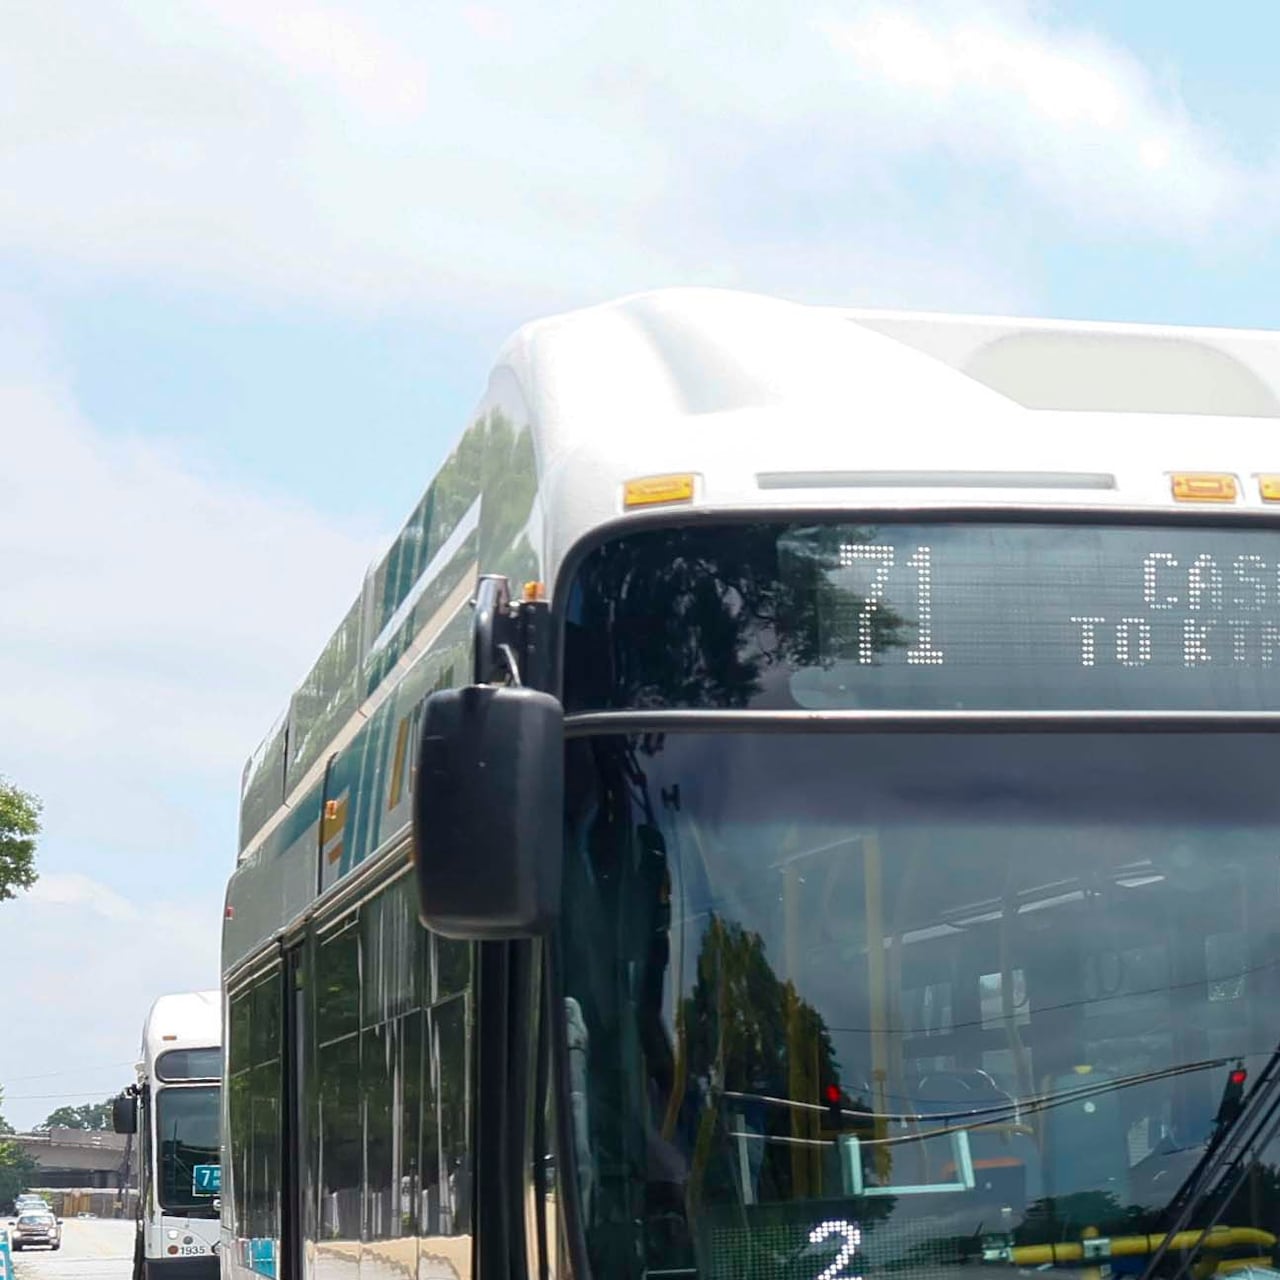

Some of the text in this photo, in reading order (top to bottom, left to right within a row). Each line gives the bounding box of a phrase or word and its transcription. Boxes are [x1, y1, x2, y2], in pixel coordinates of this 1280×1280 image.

[840, 545, 943, 665] 71
[1070, 616, 1152, 668] TO
[180, 1246, 206, 1256] 1935
